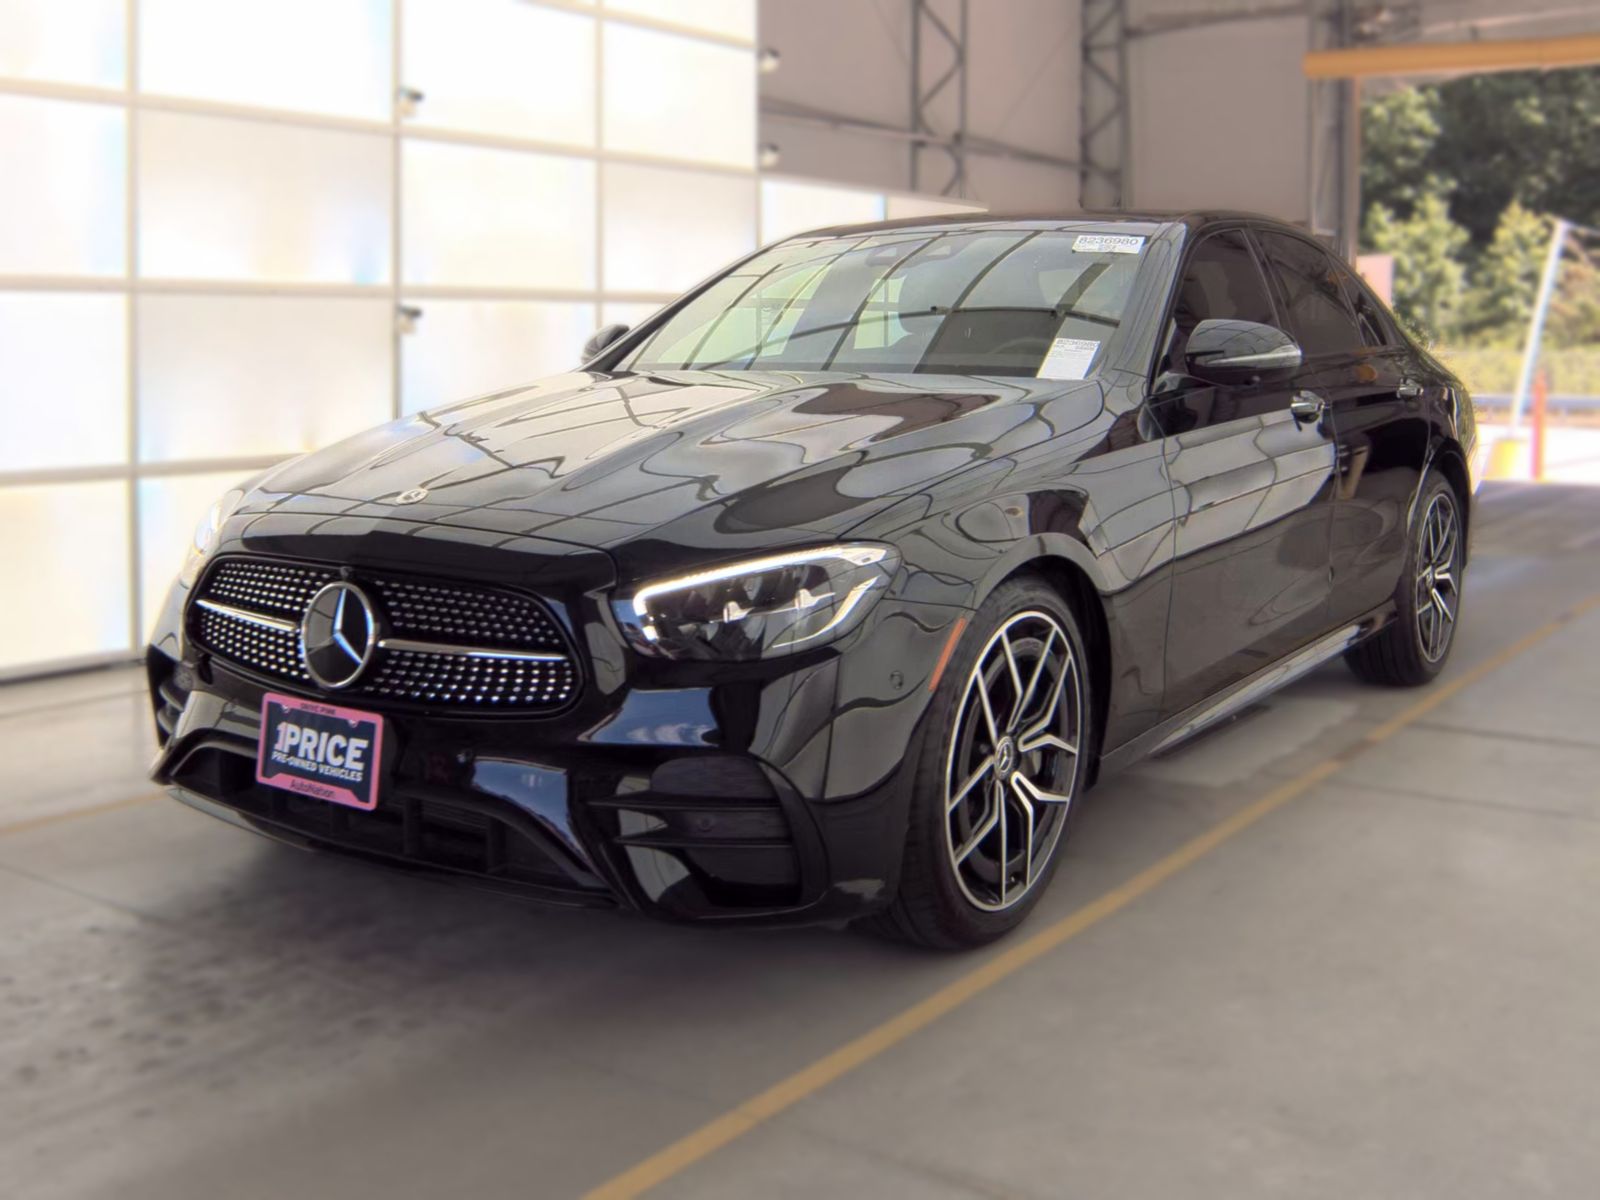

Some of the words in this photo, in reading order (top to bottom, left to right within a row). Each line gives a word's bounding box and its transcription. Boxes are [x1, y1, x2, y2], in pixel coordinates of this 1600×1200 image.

[1079, 236, 1139, 245] 8236980
[274, 721, 369, 771] 1PRICE
[271, 752, 318, 771] PRE-OWNED
[319, 764, 363, 782] VEHICLES
